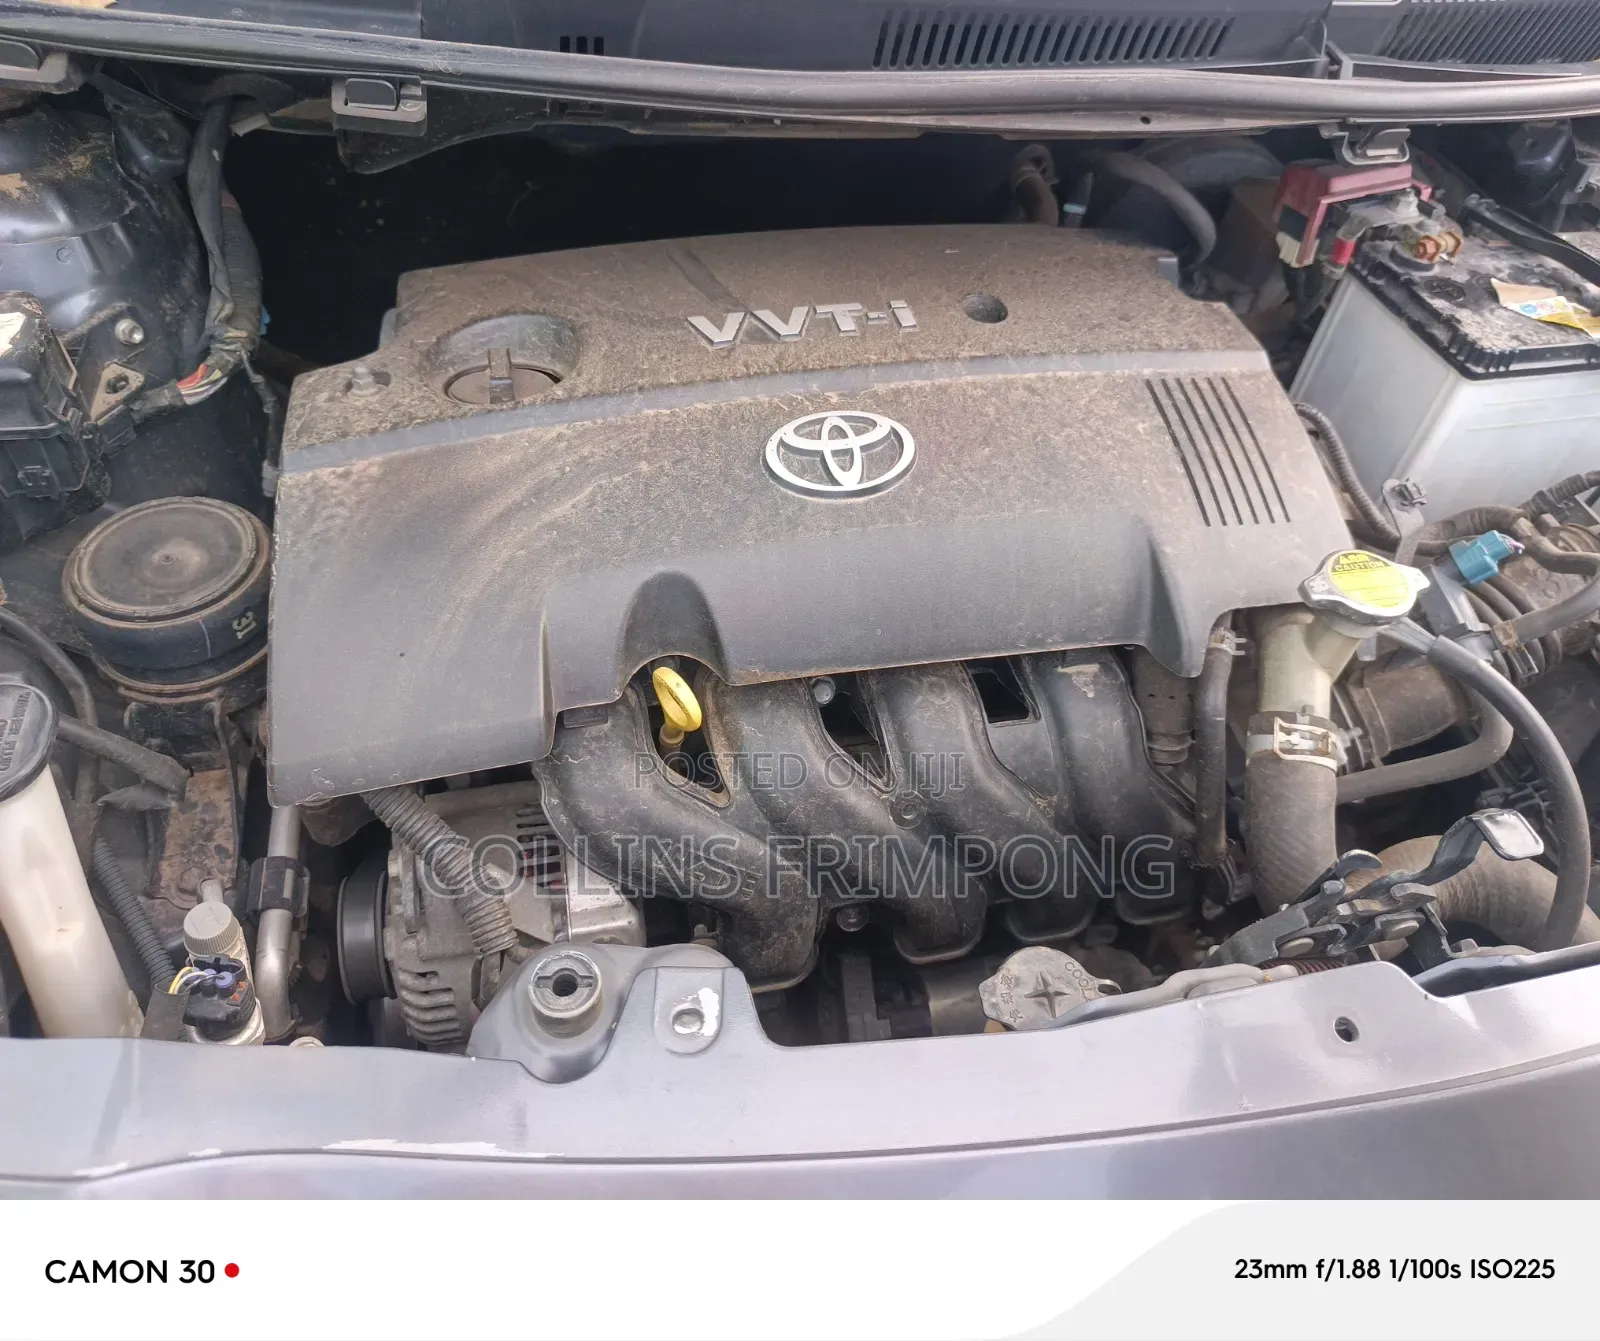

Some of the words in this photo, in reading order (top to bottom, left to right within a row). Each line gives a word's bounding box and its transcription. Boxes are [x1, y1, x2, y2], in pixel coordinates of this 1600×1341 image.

[686, 300, 917, 348] VVT-i
[1334, 560, 1386, 573] CAUTION
[7, 690, 32, 736] WASHER
